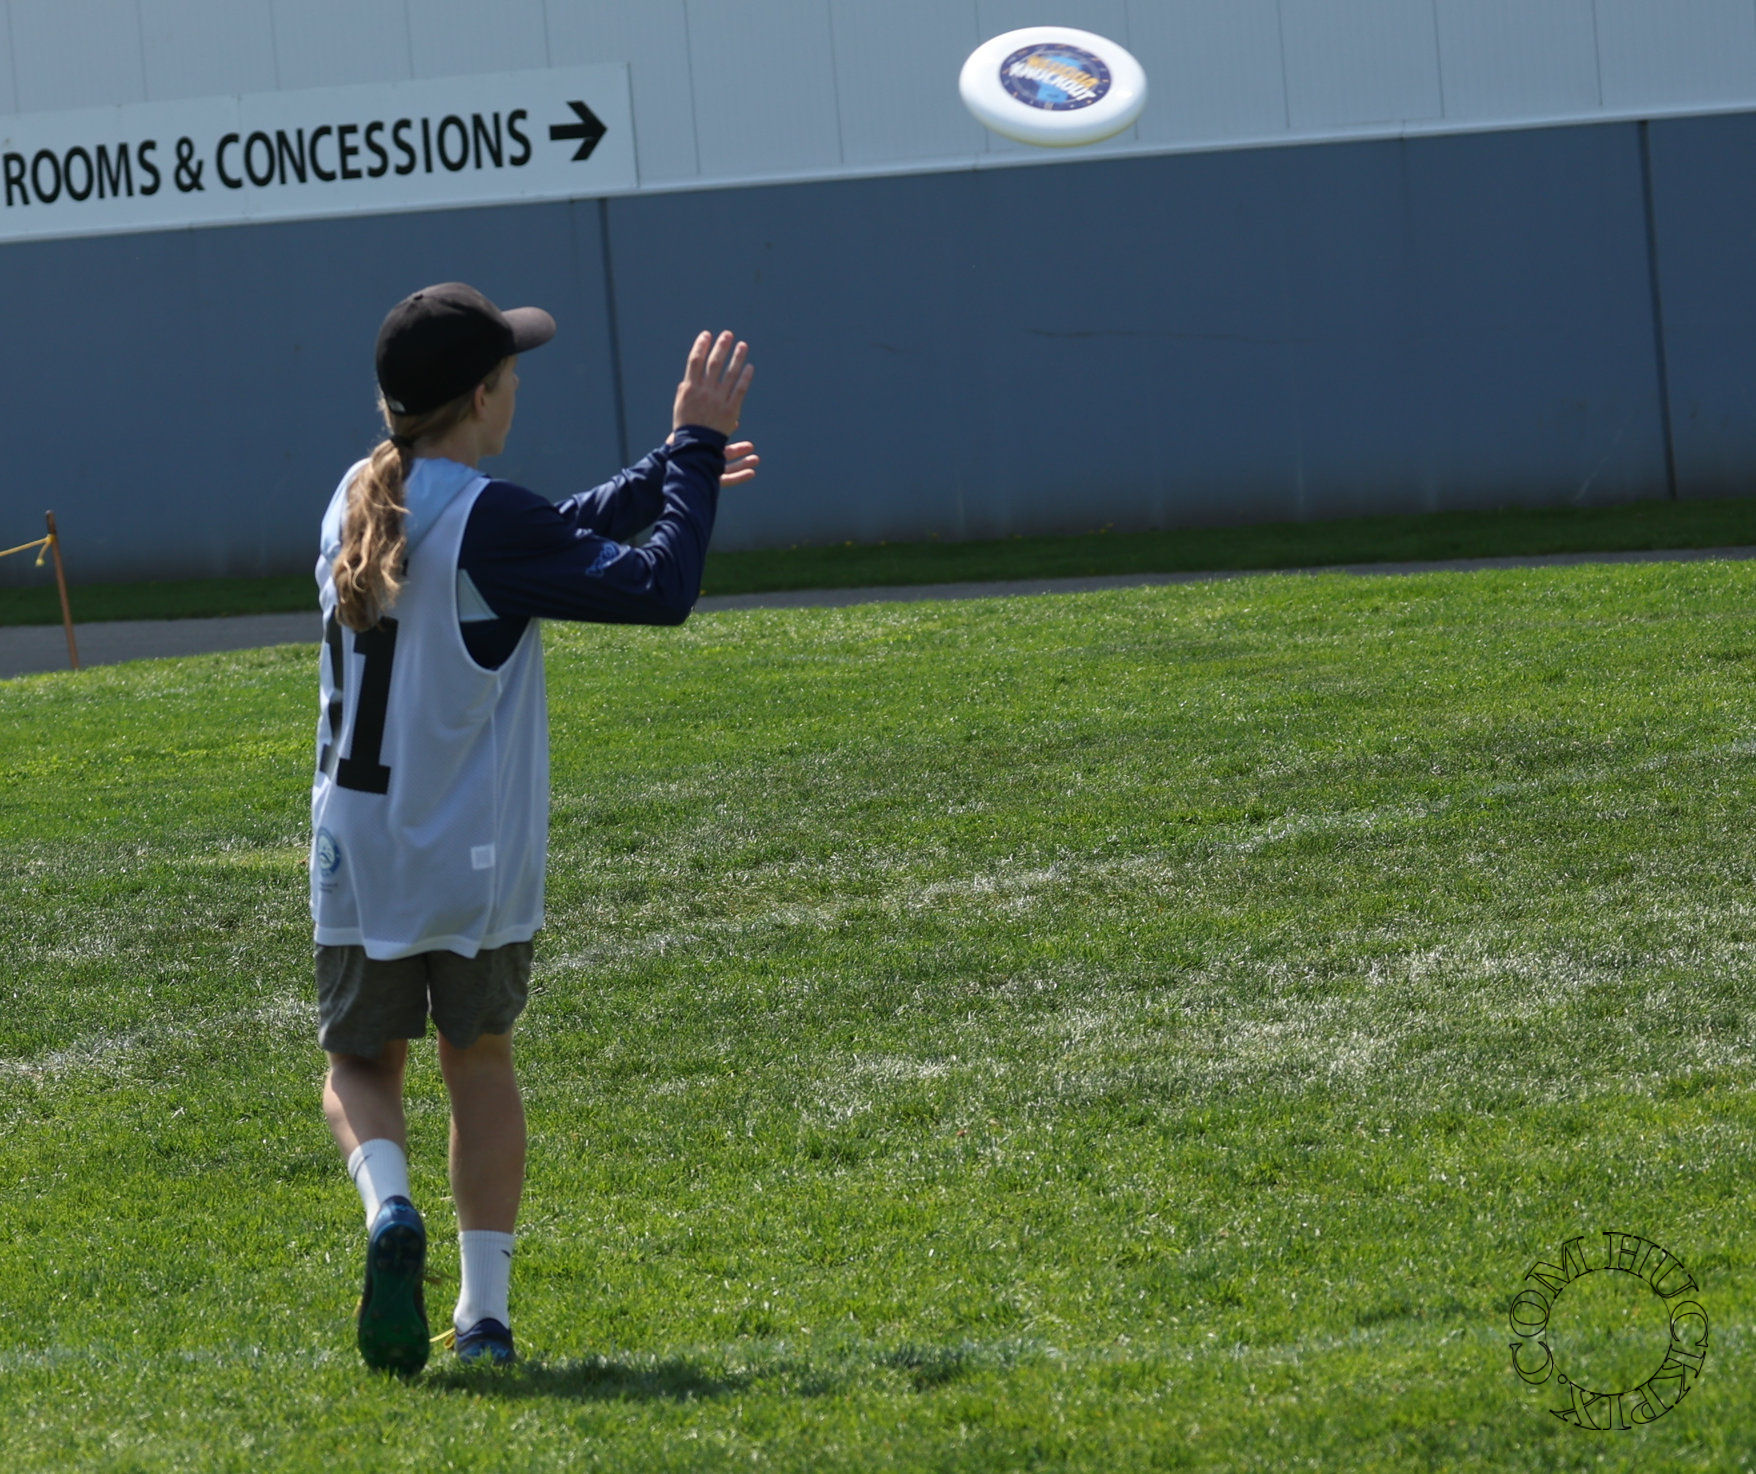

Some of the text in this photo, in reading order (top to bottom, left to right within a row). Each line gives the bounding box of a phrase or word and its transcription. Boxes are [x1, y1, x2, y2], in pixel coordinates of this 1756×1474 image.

[2, 108, 533, 208] ROOMS & CONCESSIONS
